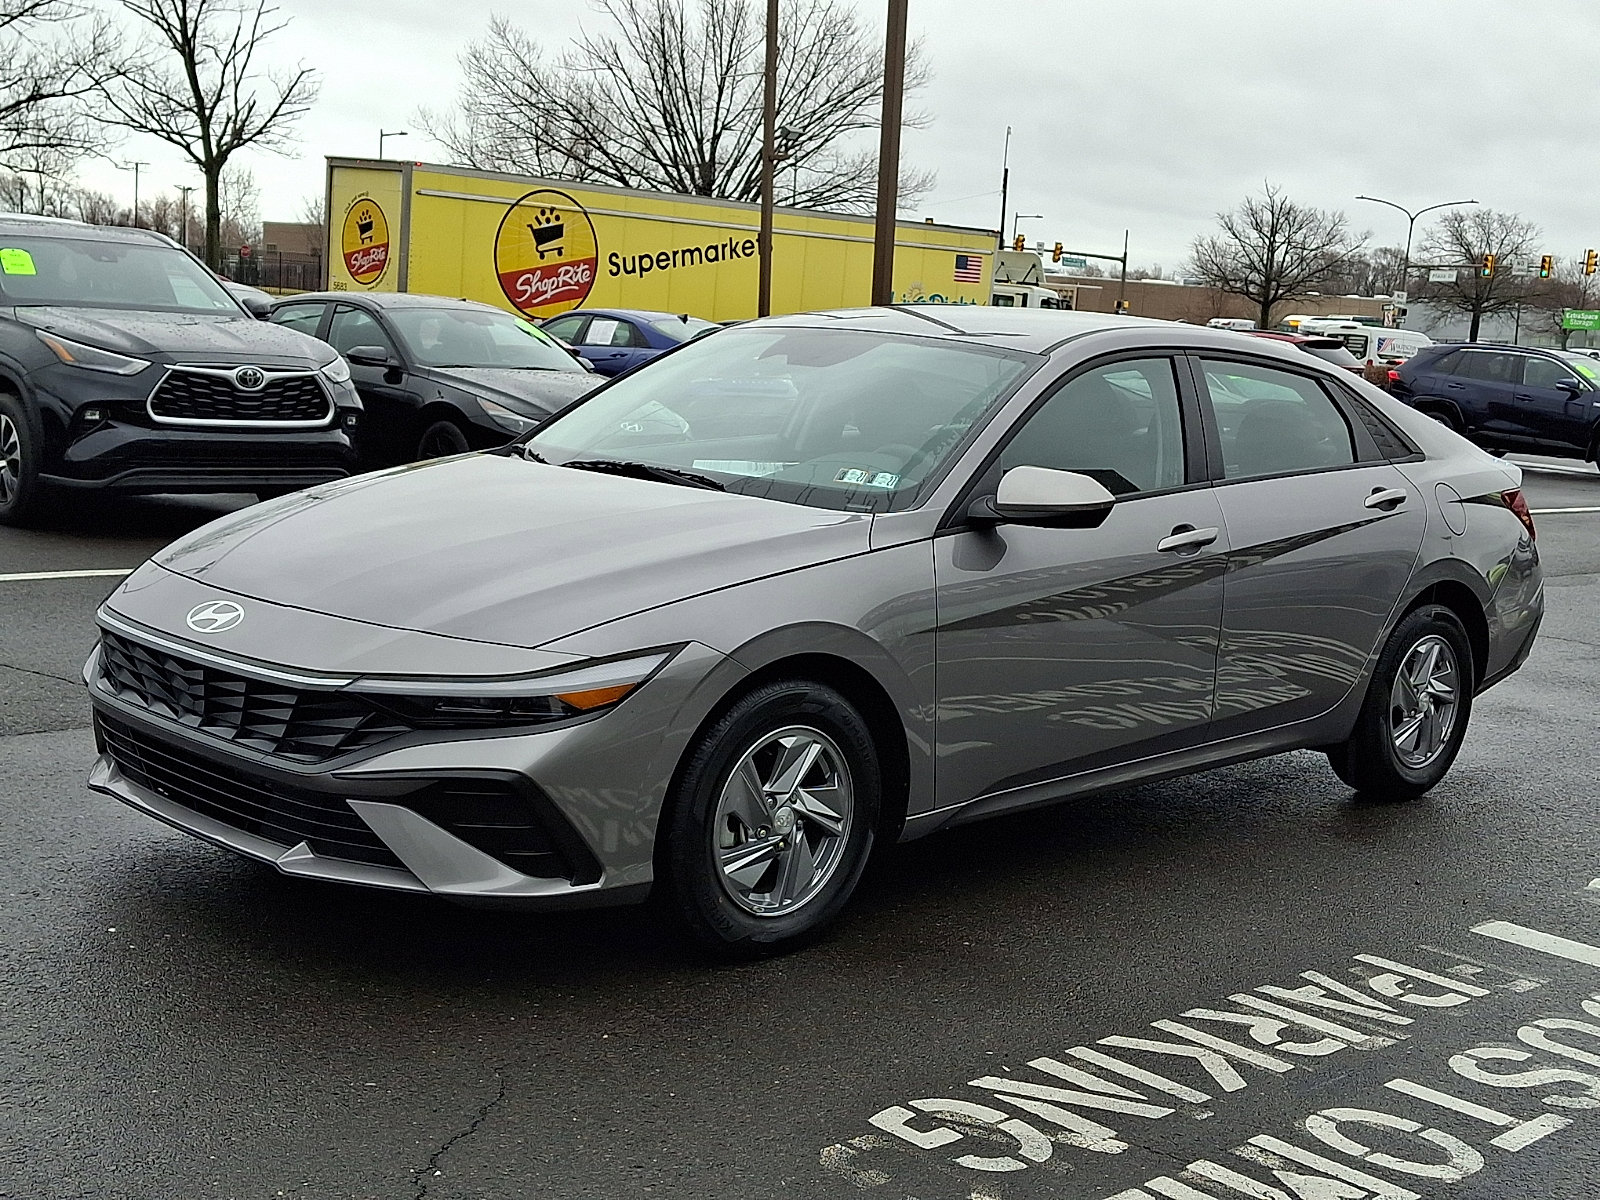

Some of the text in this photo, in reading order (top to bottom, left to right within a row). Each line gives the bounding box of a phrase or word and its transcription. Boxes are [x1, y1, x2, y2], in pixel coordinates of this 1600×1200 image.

[350, 247, 386, 271] ShopRite
[333, 281, 347, 291] 5683
[516, 262, 591, 302] ShopRite
[868, 953, 1491, 1173] PARKING
